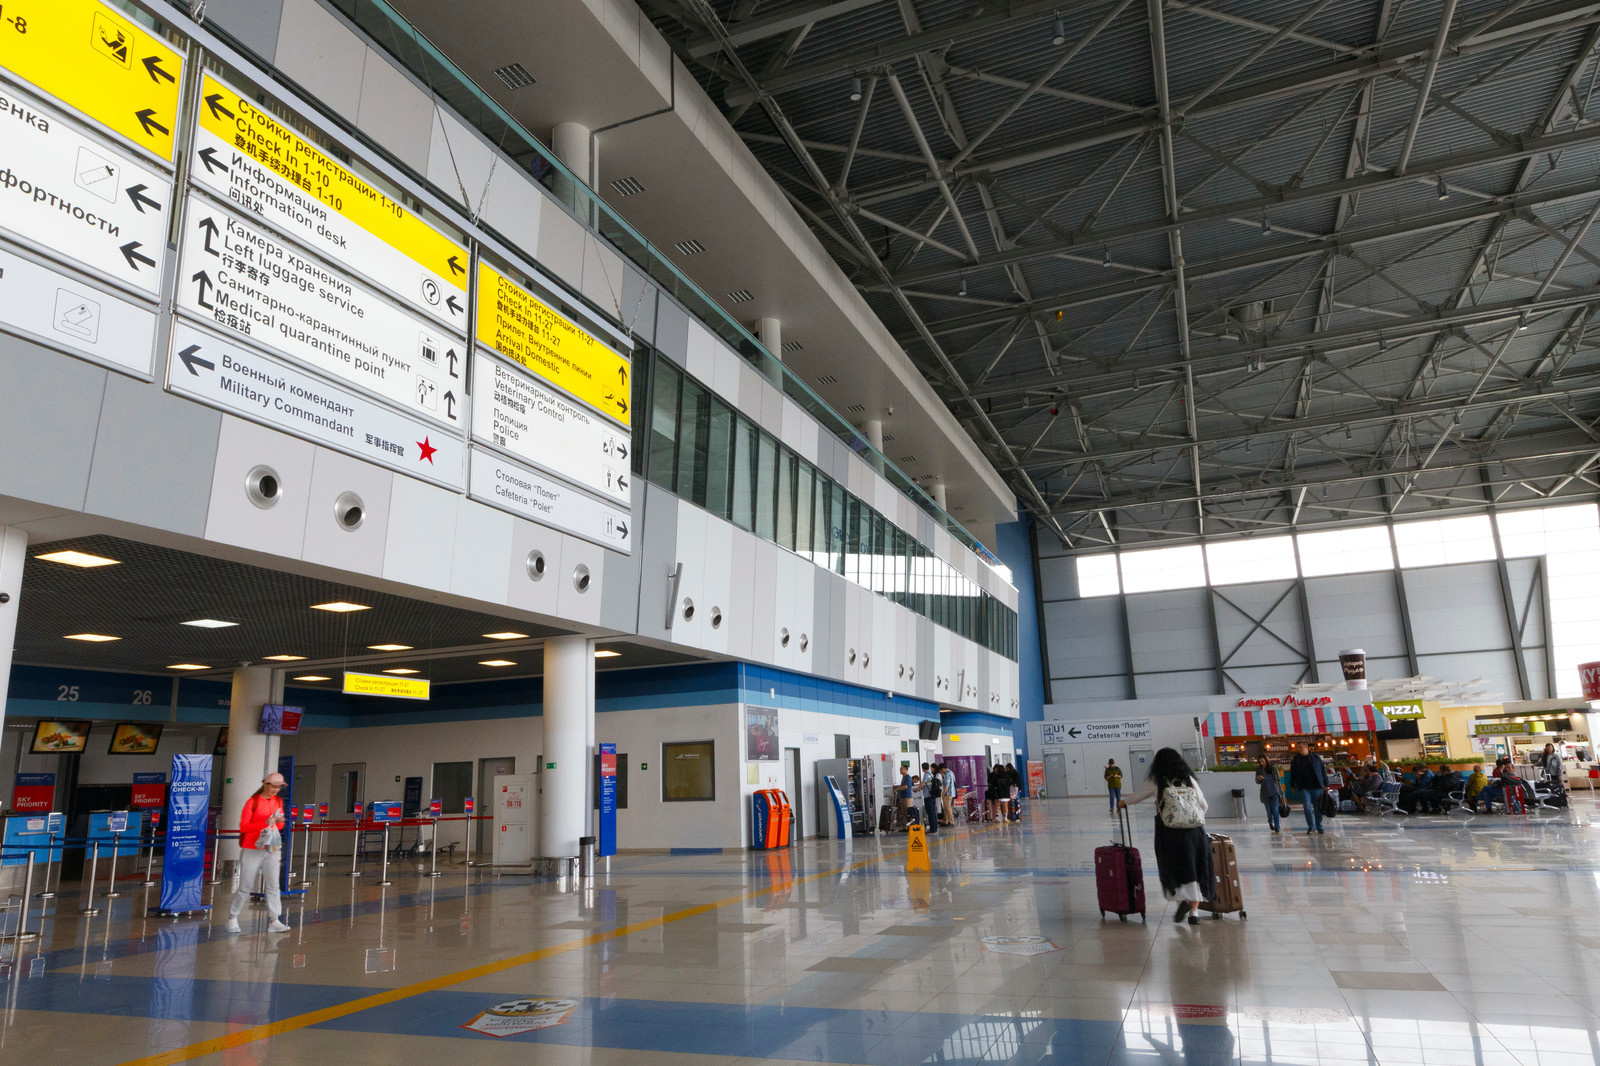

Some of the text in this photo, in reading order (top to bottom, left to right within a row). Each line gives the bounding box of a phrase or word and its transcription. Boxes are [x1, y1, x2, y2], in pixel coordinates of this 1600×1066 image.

[234, 132, 343, 211] 登机手续办理台 1-10
[236, 117, 330, 188] Check In 1-10
[238, 98, 403, 219] Стойки регистрации 1-10
[228, 186, 265, 217] 问讯处
[229, 169, 347, 250] Information desk
[231, 152, 327, 222] Информация
[222, 252, 271, 287] 行李寄存
[224, 234, 365, 319] Left luggage service
[226, 217, 352, 297] Камера хранения
[213, 307, 252, 335] 检疫站
[217, 270, 412, 373] Санитарно-карантинный пункт
[497, 288, 554, 331] Check In 11-27
[497, 276, 595, 347] Стойки регистрации 11-27
[215, 289, 386, 379] Medical quarantine point
[496, 328, 561, 375] Arrival Domestic
[528, 333, 571, 368] Внутренние
[571, 362, 592, 380] линии
[541, 328, 561, 348] 11-27
[220, 376, 354, 437] Military Commandant
[222, 354, 355, 418] Военный комендант
[495, 365, 590, 425] Ветеринарный контроль
[495, 377, 565, 423] Veterinary Control
[493, 407, 528, 433] Полиция
[493, 420, 520, 441] Police
[365, 432, 405, 457] 军事指挥官
[495, 468, 532, 491] Столовая
[495, 484, 528, 506] Cafeteria
[57, 684, 80, 702] 25
[132, 689, 153, 706] 26
[1382, 704, 1422, 716] PIZZA
[1087, 731, 1121, 739] Cafeteria
[1478, 724, 1511, 734] LUCKY
